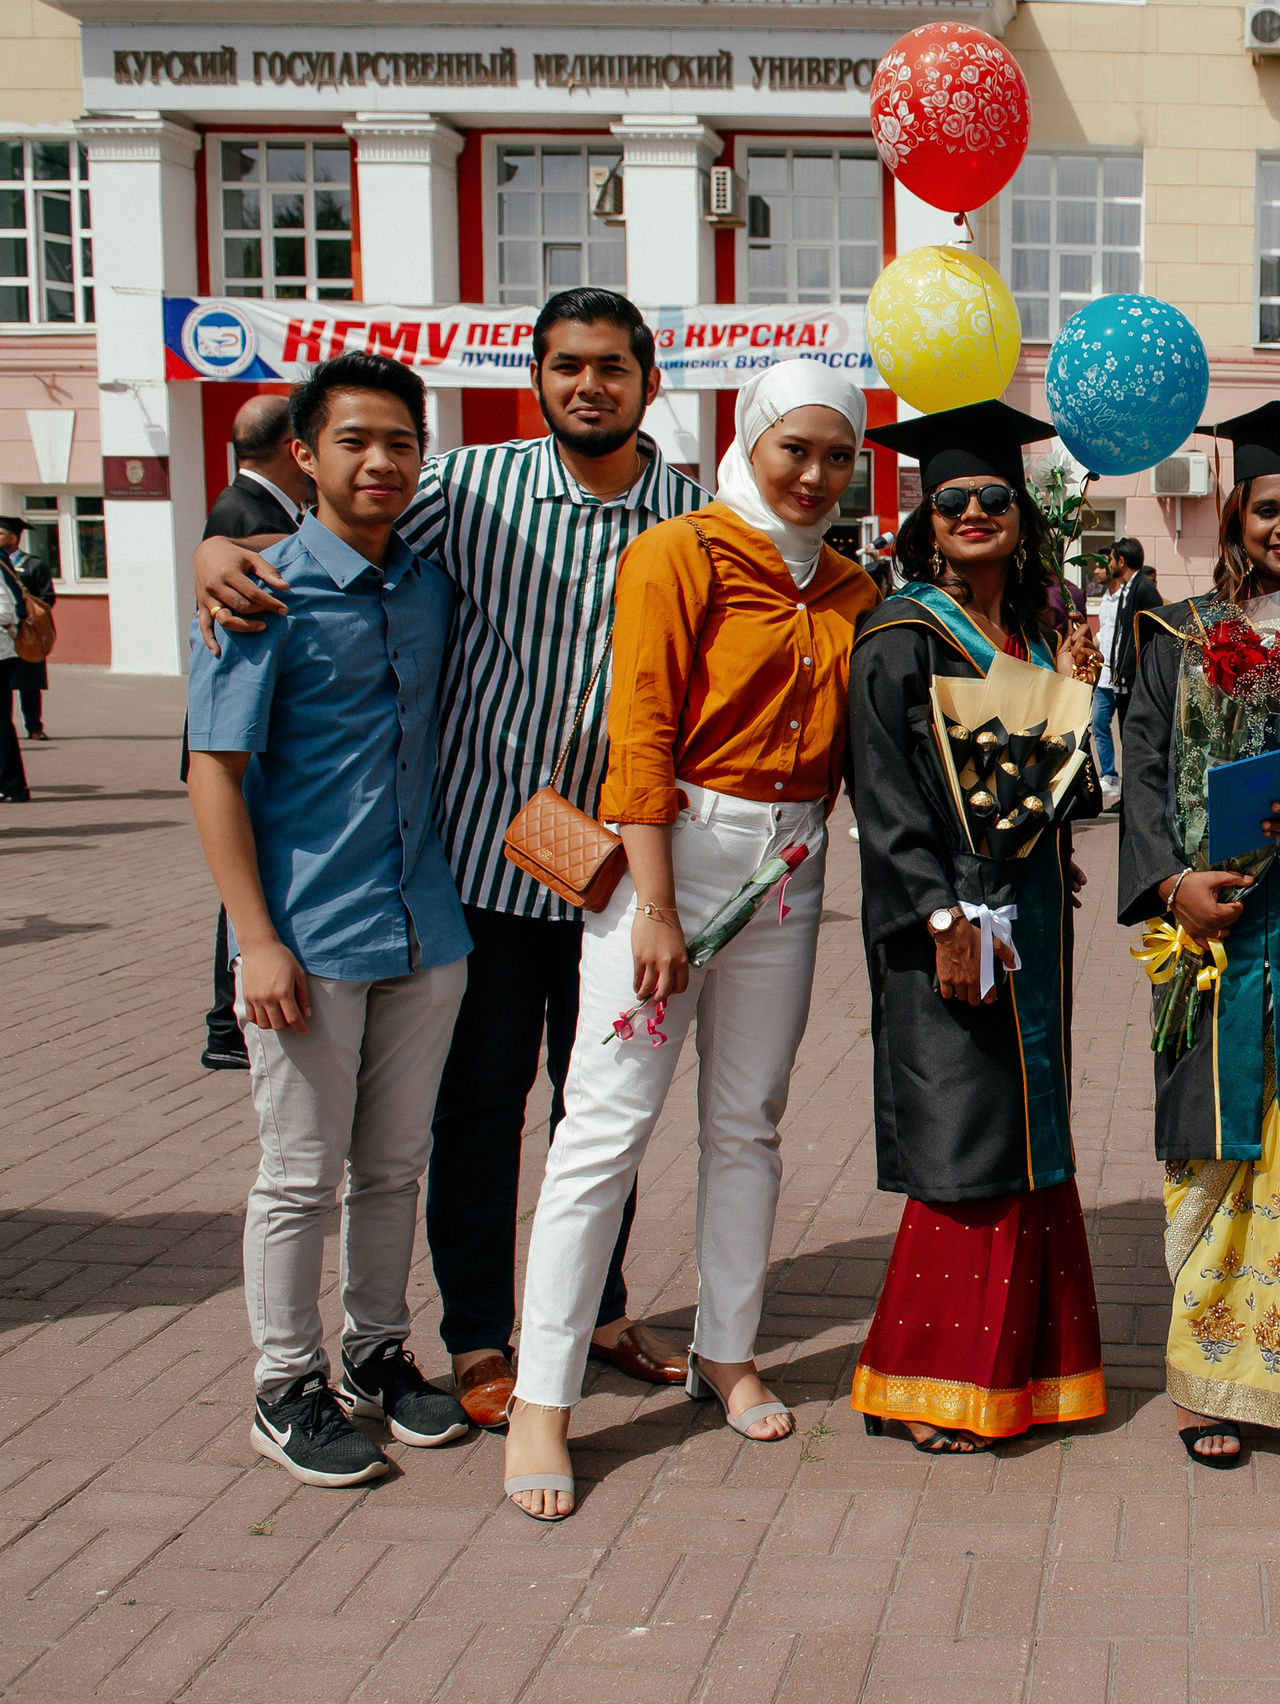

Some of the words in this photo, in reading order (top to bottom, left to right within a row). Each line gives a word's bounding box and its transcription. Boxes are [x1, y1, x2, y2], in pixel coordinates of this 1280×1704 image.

[113, 46, 238, 86] КУРСКИЙ
[252, 47, 517, 93] ГОСУДАРСТВЕННЫЙ
[533, 49, 734, 96] МЕДИЦИНСКИЙ
[282, 318, 460, 366] КГМУ
[684, 323, 830, 348] КУРСКА!
